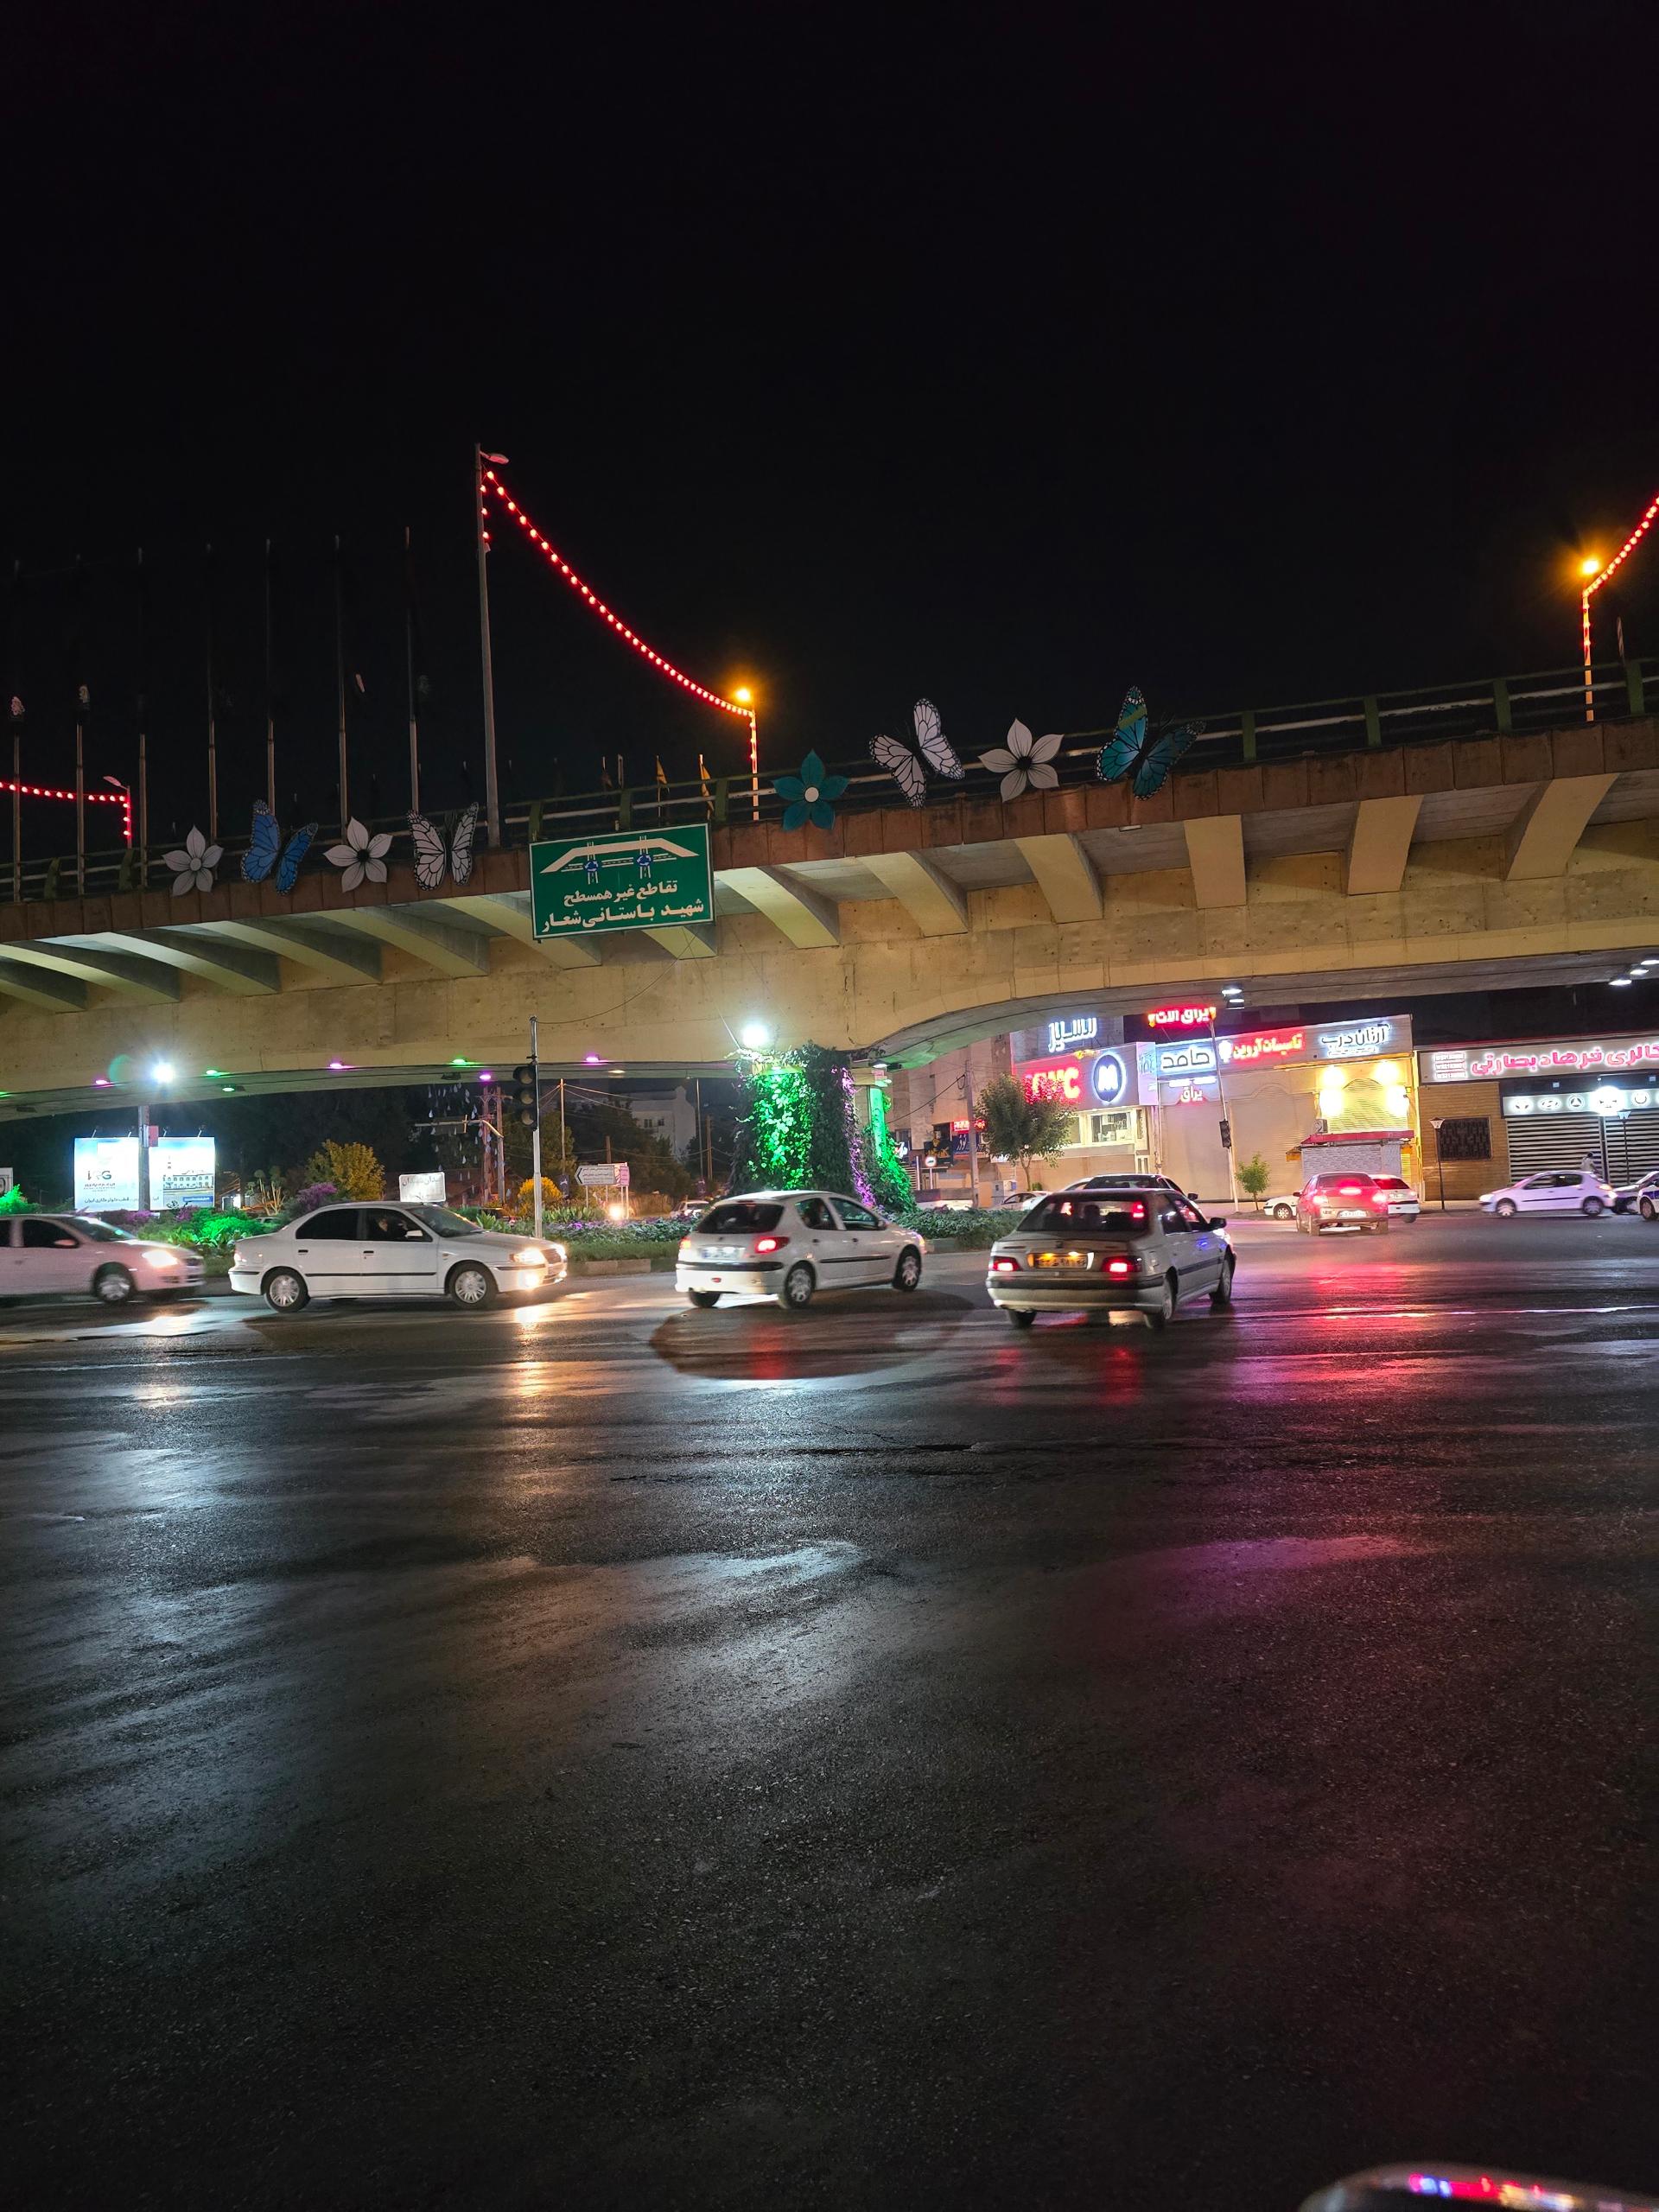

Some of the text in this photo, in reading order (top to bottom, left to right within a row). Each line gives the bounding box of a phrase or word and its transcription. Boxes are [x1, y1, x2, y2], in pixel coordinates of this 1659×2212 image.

[563, 880, 678, 907] تقاطع غیر همسطح
[542, 898, 704, 932] شهید باستانی شعار
[1162, 1048, 1211, 1069] حامد
[1541, 1047, 1603, 1070] فرهاد
[1180, 1085, 1204, 1103] یراق
